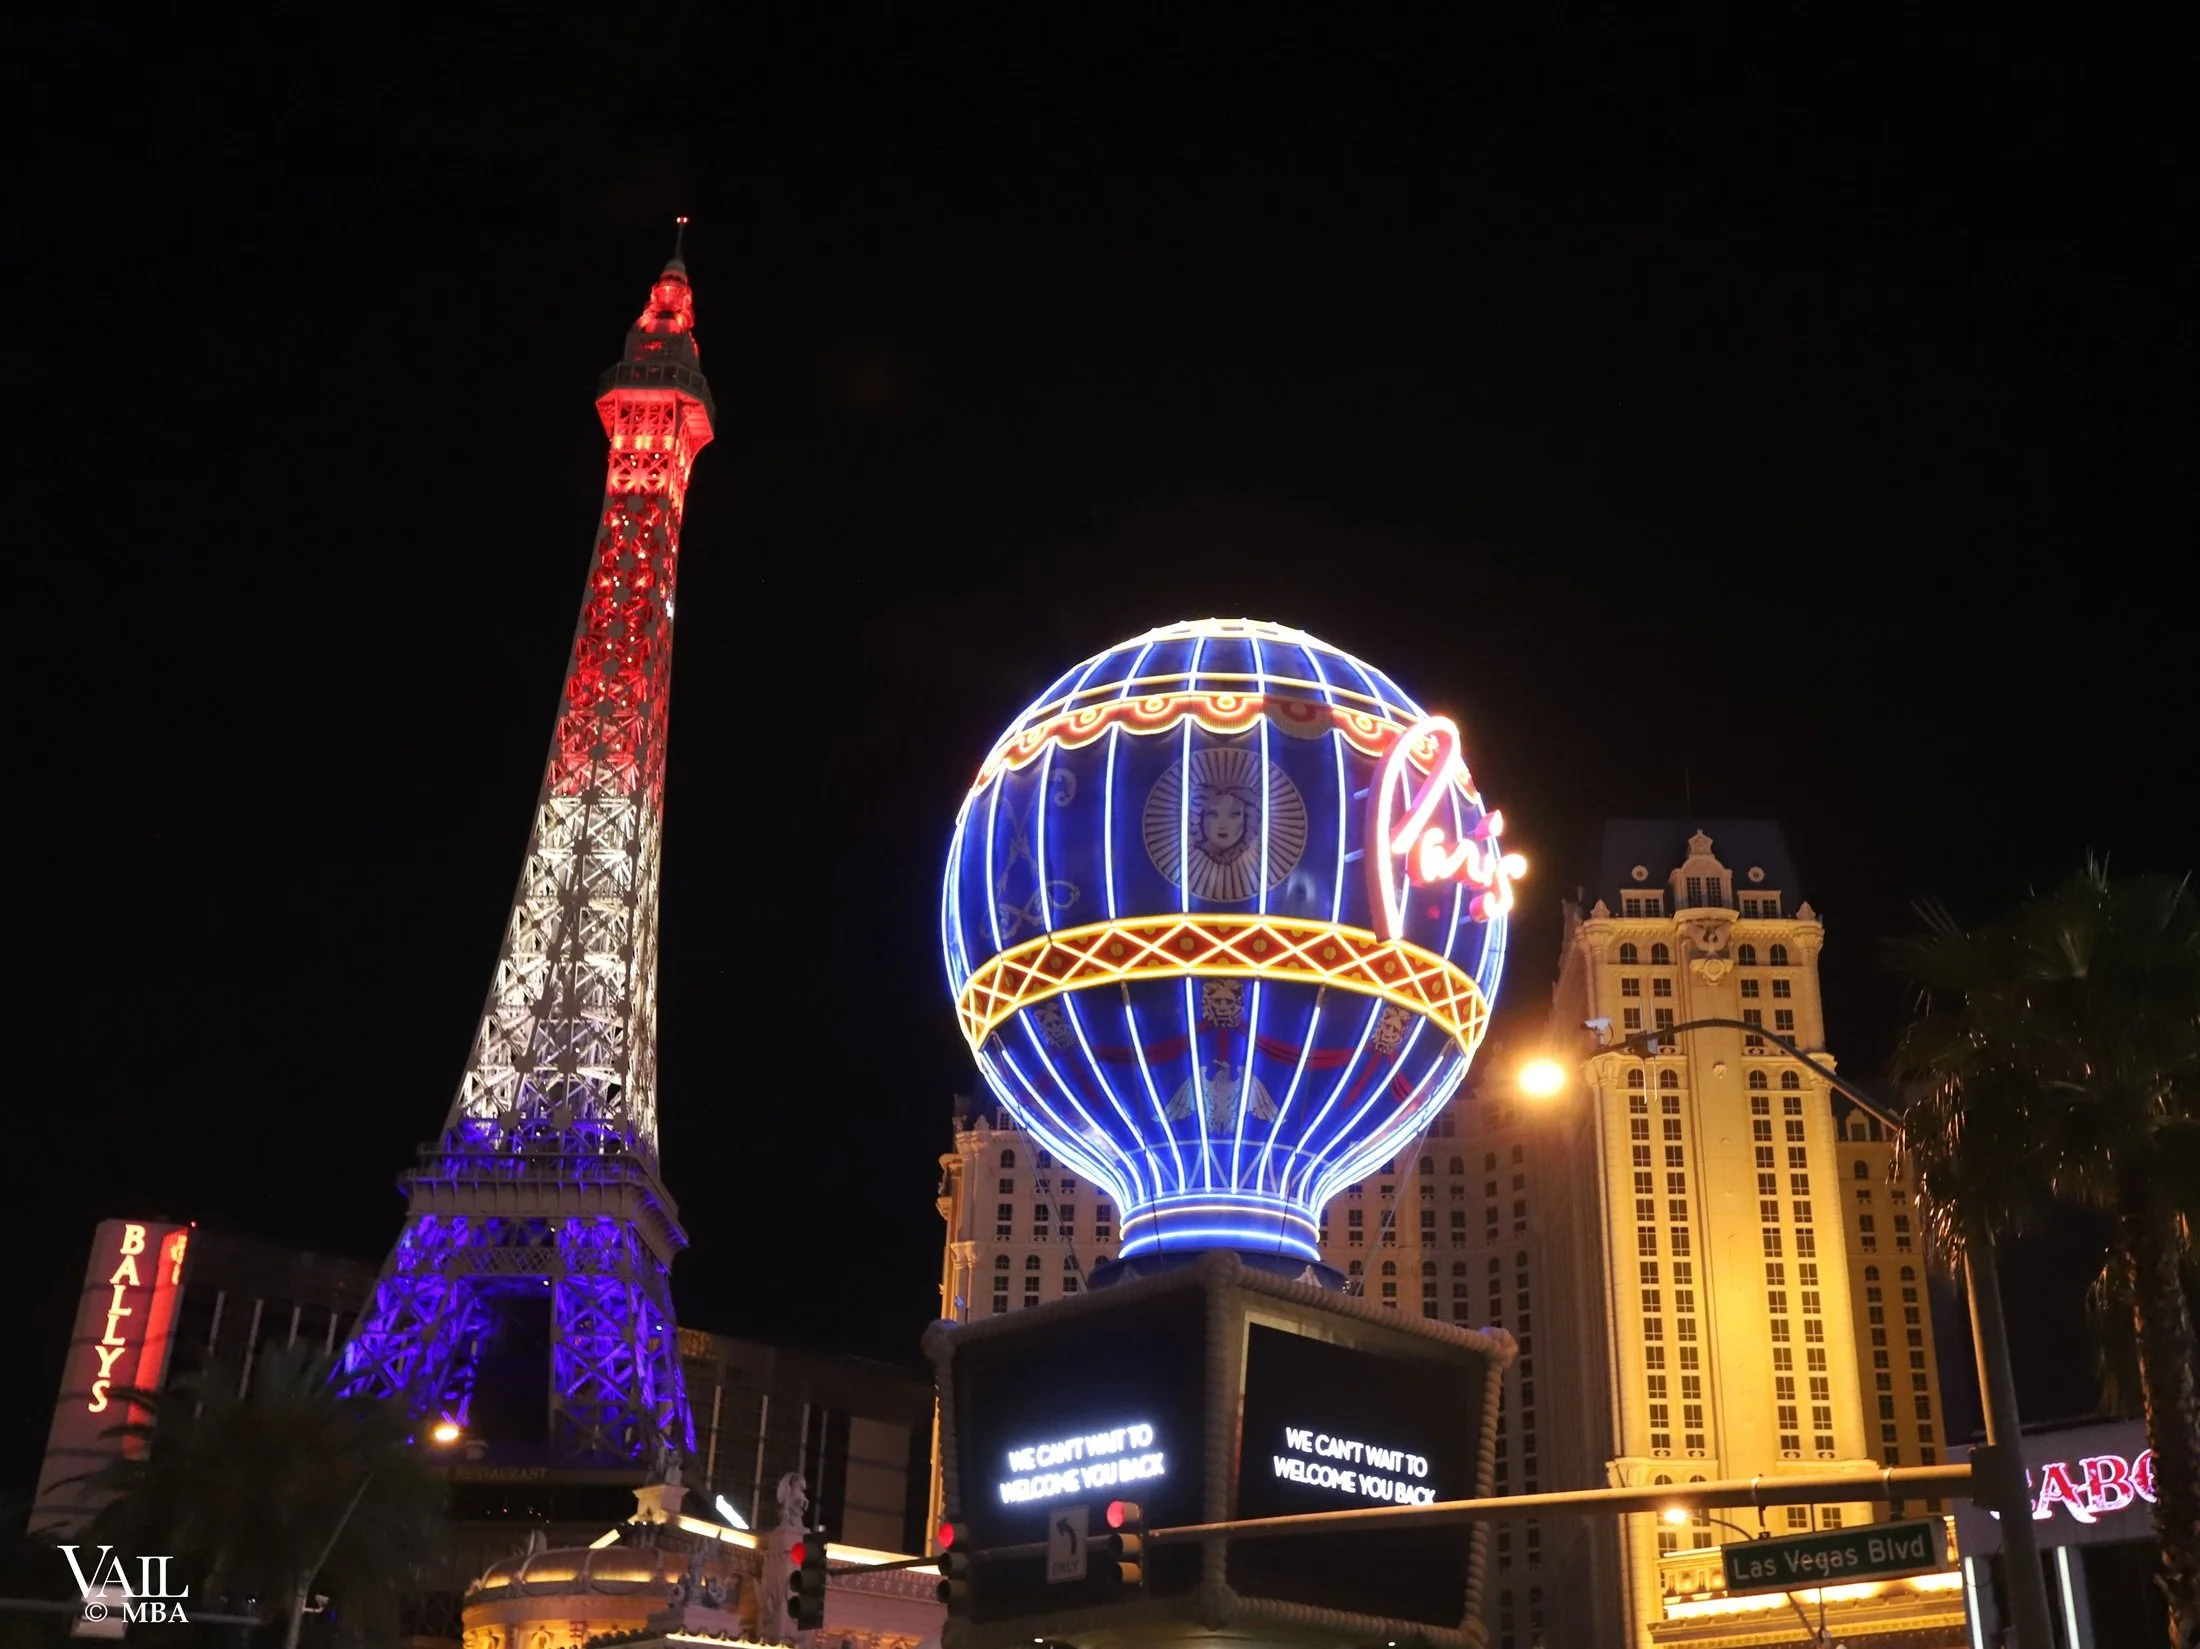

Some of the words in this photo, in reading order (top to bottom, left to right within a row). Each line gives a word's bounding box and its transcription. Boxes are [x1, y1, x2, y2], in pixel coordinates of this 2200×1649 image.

[1377, 716, 1527, 943] Paris
[88, 1224, 146, 1413] BALLYS
[1008, 1447, 1036, 1472] WE
[1085, 1429, 1126, 1457] WAIT
[1127, 1424, 1153, 1449] TO
[1286, 1427, 1313, 1453] WE
[1315, 1434, 1364, 1463] CAN'T
[1365, 1445, 1404, 1472] WAIT
[1405, 1454, 1428, 1478] TO
[455, 1467, 548, 1481] RESTAURANT
[1000, 1469, 1080, 1503] WELCOME
[1081, 1462, 1118, 1488] YOU
[1118, 1452, 1165, 1482] BACK
[1273, 1456, 1356, 1493] WELCOME
[1359, 1474, 1393, 1500] YOU
[1395, 1482, 1436, 1505] BACK
[1052, 1558, 1079, 1576] ONLY
[1733, 1557, 1777, 1581] Las
[1784, 1548, 1858, 1577] Vegas
[1868, 1534, 1925, 1563] Blvd
